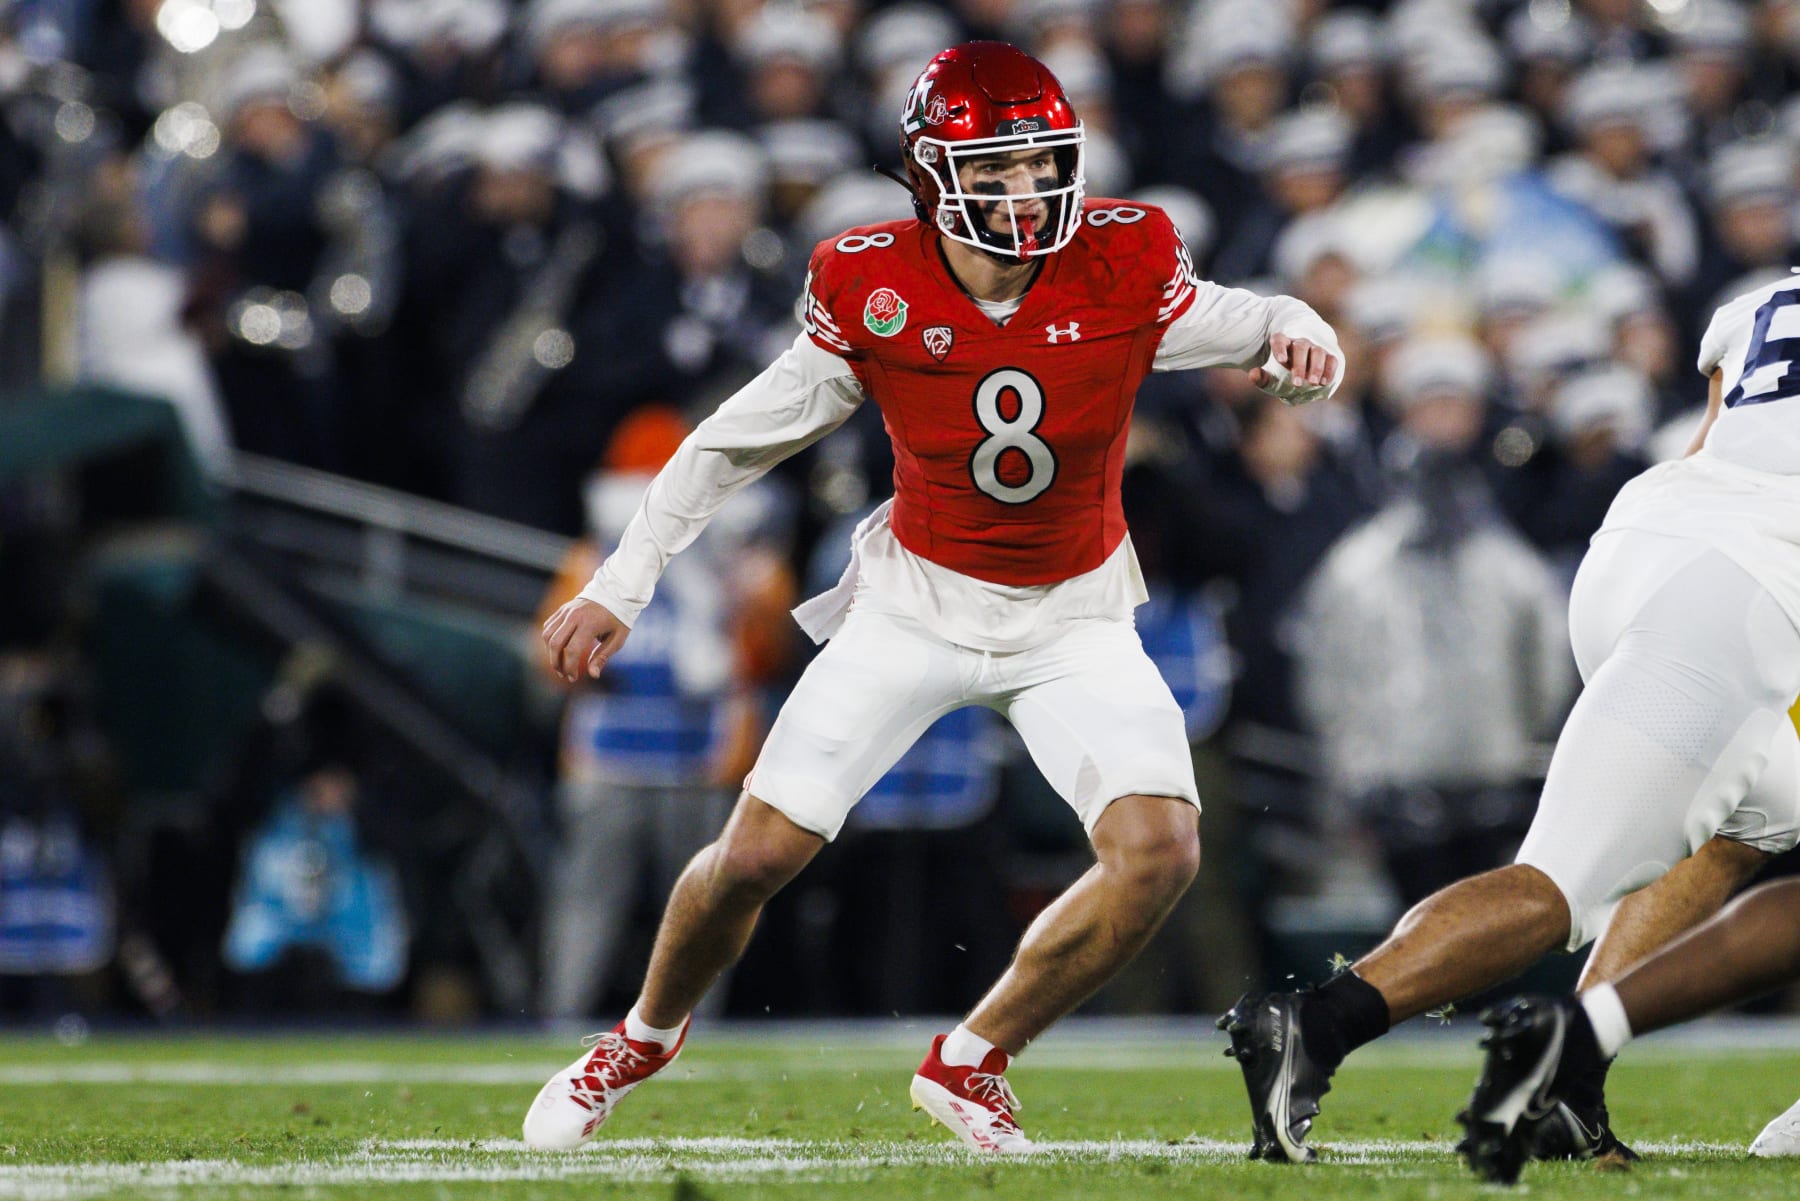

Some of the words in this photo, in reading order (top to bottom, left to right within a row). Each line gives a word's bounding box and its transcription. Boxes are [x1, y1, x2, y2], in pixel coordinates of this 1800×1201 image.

[1087, 206, 1147, 227] 8
[836, 232, 895, 254] 8
[923, 326, 953, 349] PAC
[931, 340, 948, 355] 12
[969, 366, 1058, 504] 8
